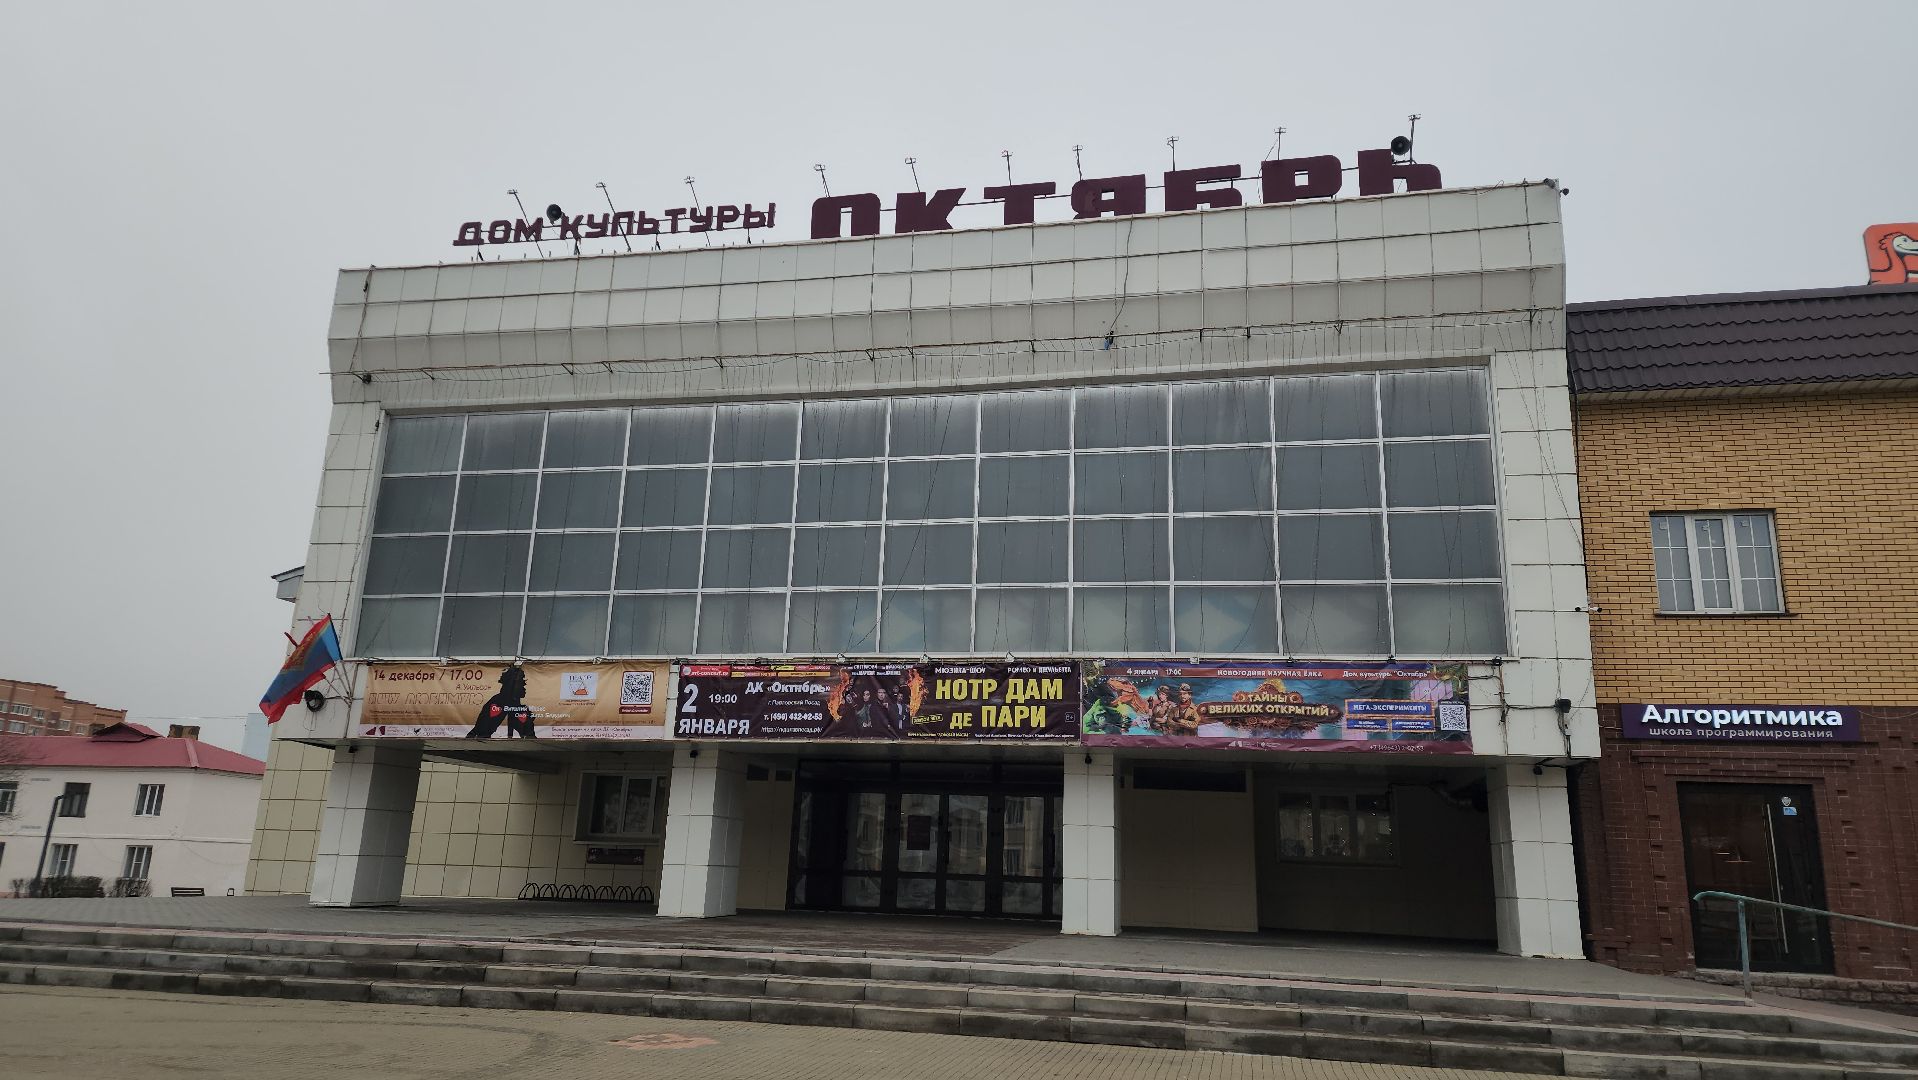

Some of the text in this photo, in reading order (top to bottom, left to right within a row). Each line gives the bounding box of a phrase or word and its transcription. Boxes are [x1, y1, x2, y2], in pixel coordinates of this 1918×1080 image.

[810, 149, 1442, 239] ОКТЯБРЬ
[453, 202, 776, 246] ДОМ КУЛЬТУРЫ
[374, 669, 386, 680] 14
[389, 667, 435, 682] декабря
[450, 669, 483, 680] 17.00
[745, 681, 831, 695] ДК «Октябрь»
[935, 678, 1063, 704] НОТР ДАМ
[682, 684, 699, 713] 2
[708, 694, 738, 704] 19:00
[1248, 691, 1287, 703] ТАЙНЫ
[950, 712, 972, 729] ДЕ
[981, 705, 1046, 728] ПАРИ
[1208, 703, 1330, 716] ВЕЛИКИХ ОТКРЫТИЙ
[1641, 705, 1843, 729] Алгоритмика
[678, 718, 749, 735] ЯНВАРЯ
[1649, 727, 1834, 739] школа программирования
